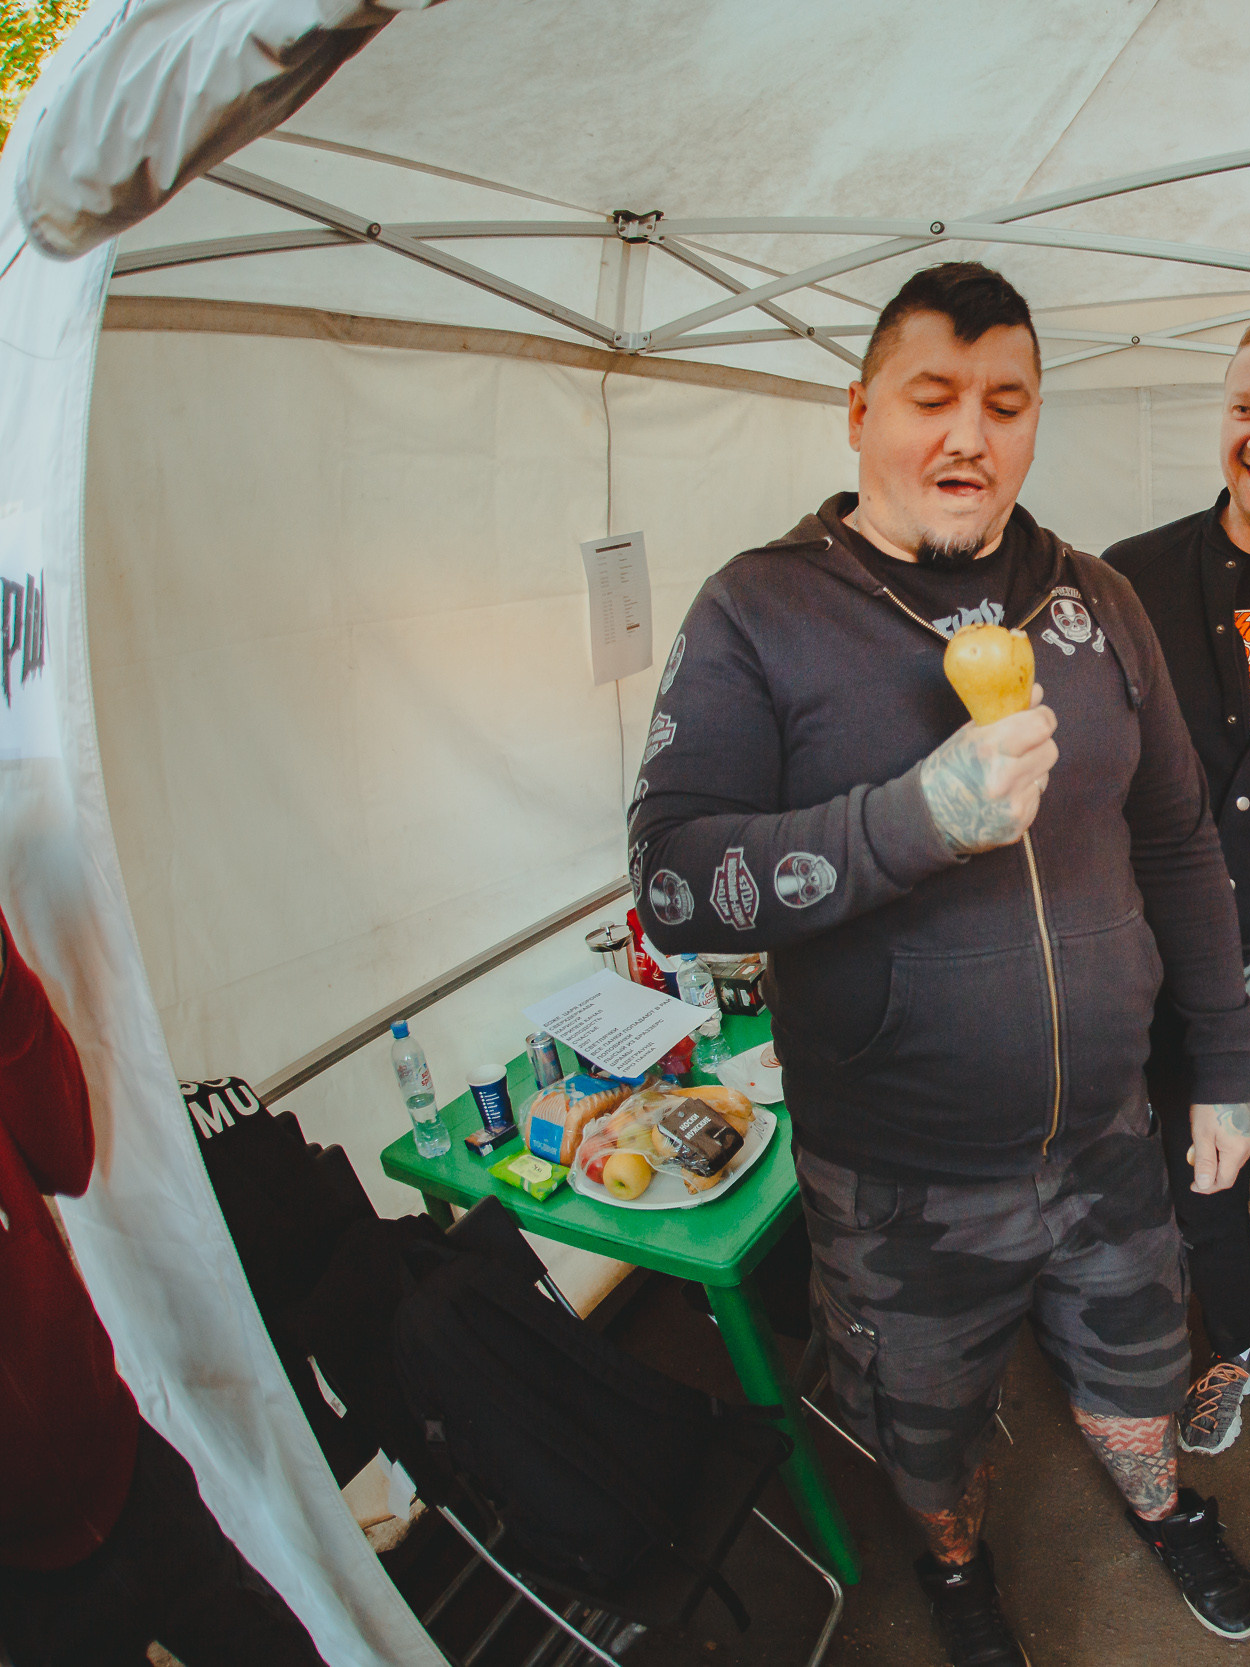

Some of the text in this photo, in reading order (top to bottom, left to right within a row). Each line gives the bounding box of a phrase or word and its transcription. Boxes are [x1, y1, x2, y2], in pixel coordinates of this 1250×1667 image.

[560, 1022, 584, 1038] ПРИПЕВ
[566, 1017, 603, 1042] МОЛОДОСТЬ
[572, 1026, 599, 1044] СЧАСТЬЕ
[584, 1028, 618, 1052] СВЕТЛЯЧКИ
[590, 1046, 603, 1057] ВСЕ
[602, 1032, 623, 1048] ПАНКИ
[622, 1010, 655, 1033] ПОПАДАЮТ
[634, 1018, 664, 1040] БРАЗЗЕРС
[597, 1034, 633, 1060] ПОЛОВИНКИ
[610, 1049, 634, 1067] ШРАМЫ
[617, 1042, 655, 1070] АНДЕГРАУНД
[622, 1061, 636, 1072] ПРО
[679, 1113, 700, 1132] НОСКИ
[684, 1116, 712, 1140] МУЖСКИЕ
